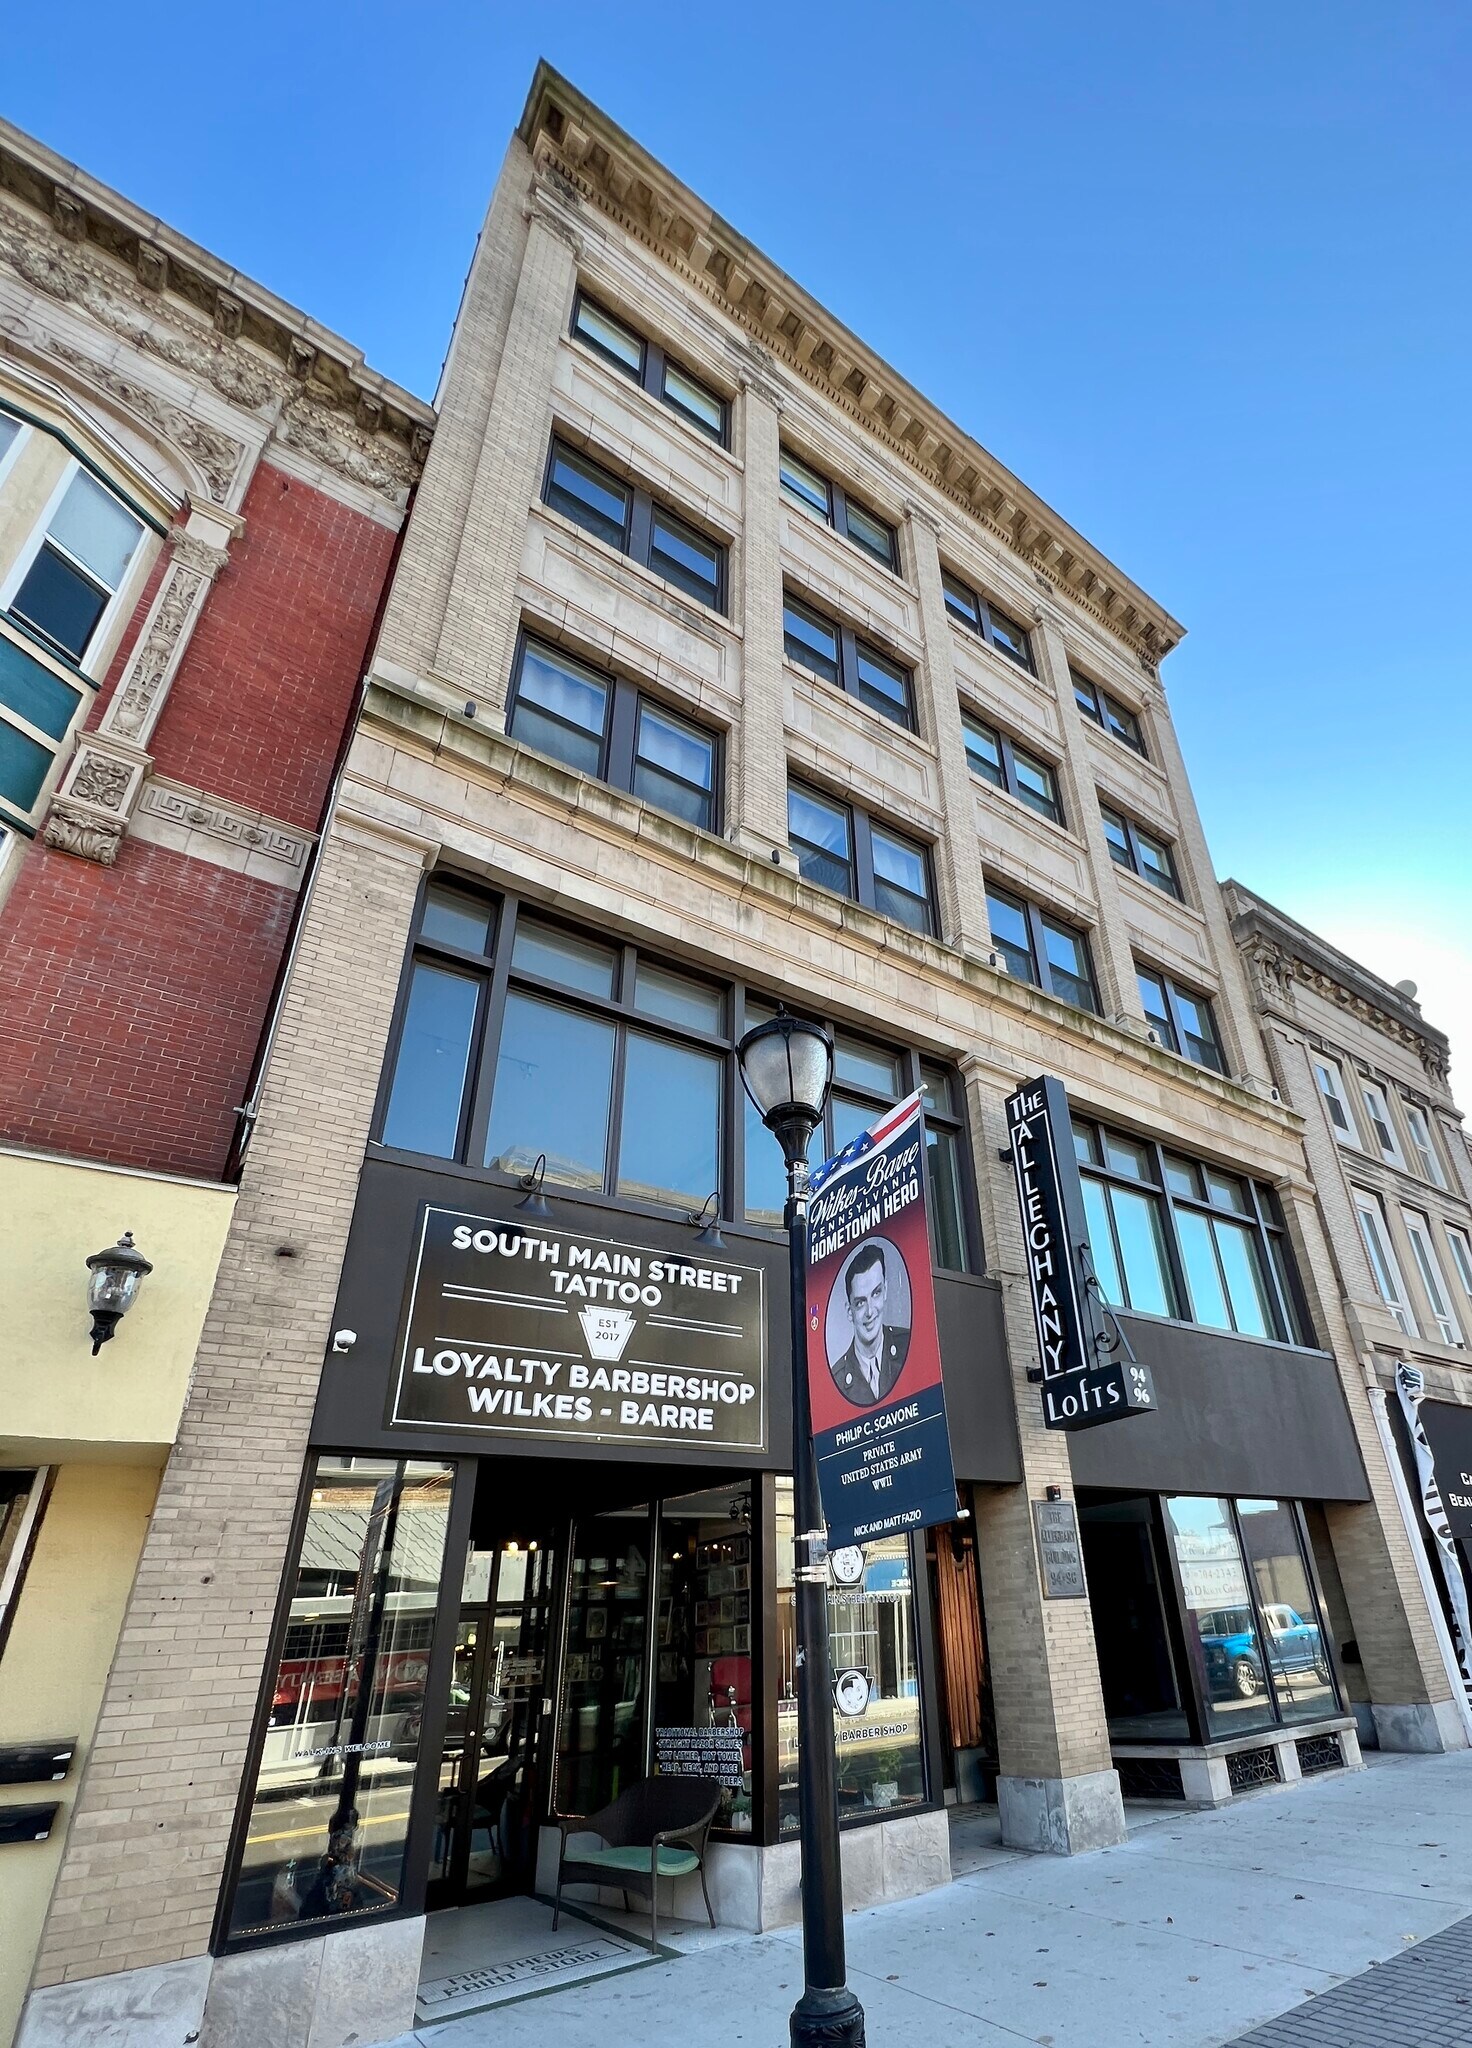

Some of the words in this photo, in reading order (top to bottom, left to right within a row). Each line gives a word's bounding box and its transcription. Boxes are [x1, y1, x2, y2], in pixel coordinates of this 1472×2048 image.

[810, 1141, 920, 1230] Wilkes-Barre
[812, 1165, 917, 1243] PENNSYLVANIA
[811, 1204, 880, 1264] HOMETOWN
[884, 1178, 918, 1219] HERO
[1018, 1120, 1064, 1371] ALLEGHANY
[452, 1225, 560, 1262] SOUTH
[568, 1247, 642, 1278] MAIN
[647, 1261, 742, 1294] STREET
[550, 1270, 662, 1307] TATTOO
[595, 1331, 620, 1341] 2017
[598, 1318, 618, 1328] EST
[412, 1346, 562, 1386] LOYALTY
[569, 1364, 756, 1405] BARBERSHOP
[1130, 1366, 1146, 1382] 94
[467, 1386, 592, 1422] WILKES
[620, 1400, 714, 1431] BARRE
[1133, 1388, 1150, 1404] 96
[836, 1425, 862, 1446] PHILIP
[864, 1422, 873, 1436] C.
[875, 1402, 918, 1432] SCAVONE
[863, 1441, 896, 1461] PRIVATE
[841, 1466, 870, 1484] UNITED
[870, 1457, 899, 1475] STATES
[900, 1448, 922, 1466] ARMY
[872, 1475, 892, 1490] WWII
[854, 1526, 868, 1536] NICK
[868, 1521, 882, 1532] AND
[884, 1514, 901, 1529] MATT
[902, 1509, 921, 1524] FAZIO
[656, 1728, 697, 1737] TRADITIONAL
[699, 1727, 744, 1737] BARBERSHOP
[691, 1740, 714, 1748] RAZOR
[715, 1740, 743, 1748] SHAVES
[842, 1728, 880, 1742] BARBER
[883, 1723, 908, 1736] SHOP
[344, 1740, 391, 1754] WELCOME
[702, 1751, 716, 1760] HOT
[718, 1751, 742, 1761] TOWEL
[704, 1764, 718, 1772] AND
[720, 1764, 738, 1773] FACE
[443, 1973, 516, 1996] PAINT
[531, 1950, 608, 1974] STORE
[448, 1948, 580, 1985] MATTHEWS
